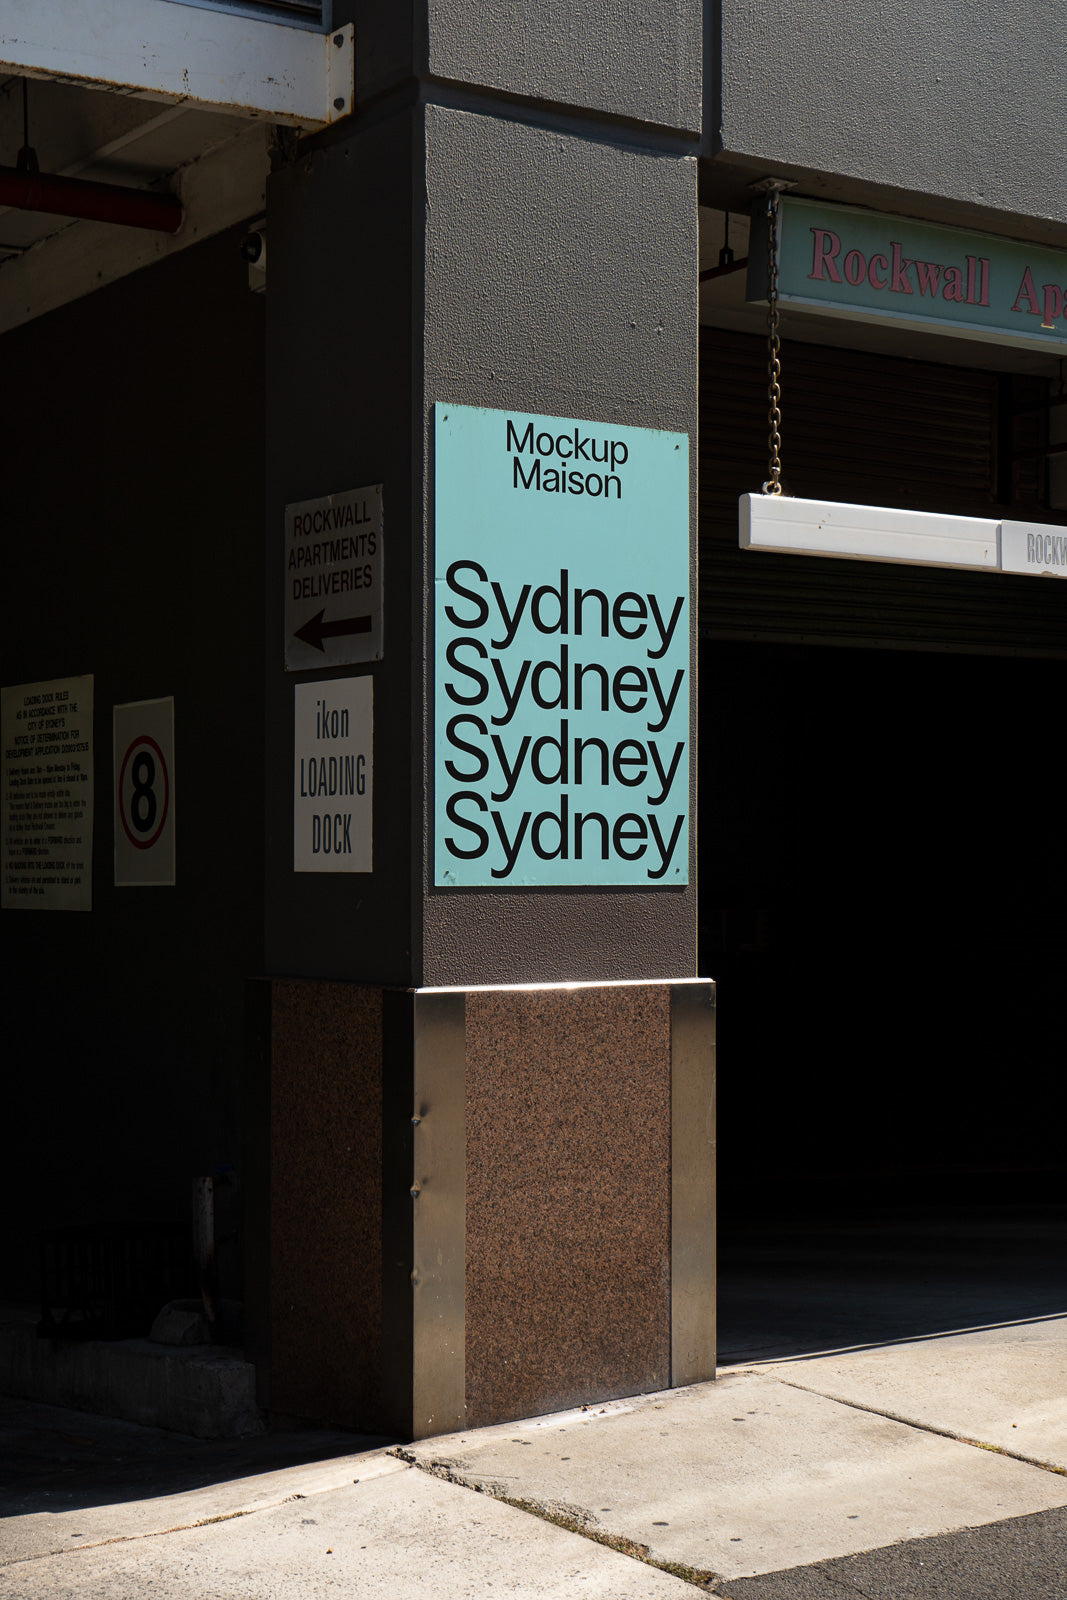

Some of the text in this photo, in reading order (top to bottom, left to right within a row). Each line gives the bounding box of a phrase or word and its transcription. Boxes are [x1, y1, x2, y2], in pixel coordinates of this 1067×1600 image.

[807, 227, 991, 308] Rockwall
[506, 419, 629, 471] Mockup
[513, 457, 622, 499] Maison
[293, 501, 371, 537] ROCKWALL
[288, 532, 377, 571] APARTMENTS
[293, 564, 373, 601] DELIVERIES
[444, 559, 685, 660] Sydney
[444, 637, 685, 733] Sydney
[316, 700, 349, 740] ikon
[300, 754, 366, 798] LOADING
[444, 714, 685, 806] Sydney
[131, 751, 157, 833] 8
[312, 813, 352, 854] DOCK
[444, 791, 685, 879] Sydney
